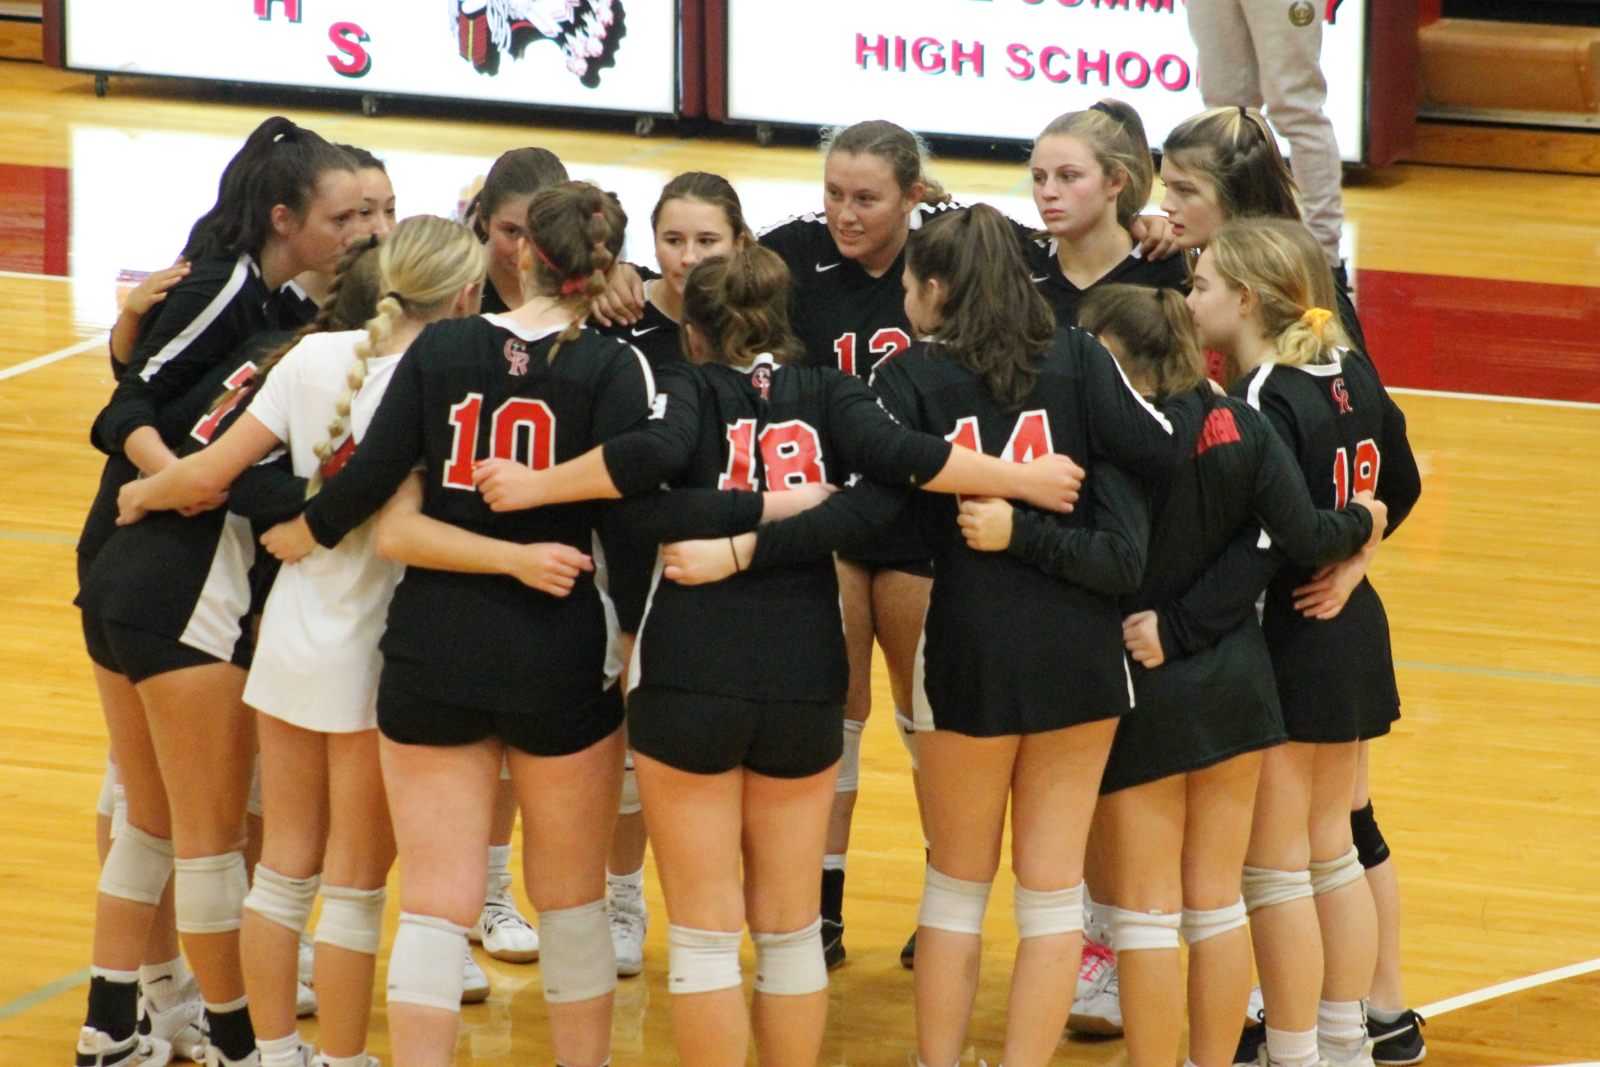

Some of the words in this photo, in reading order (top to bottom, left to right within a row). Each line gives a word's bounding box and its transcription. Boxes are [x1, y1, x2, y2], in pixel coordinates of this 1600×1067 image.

[326, 21, 372, 79] S
[855, 32, 985, 78] HIGH
[1005, 43, 1201, 92] SCHOO
[833, 327, 911, 387] 12
[442, 392, 557, 492] 10
[718, 418, 827, 493] 18
